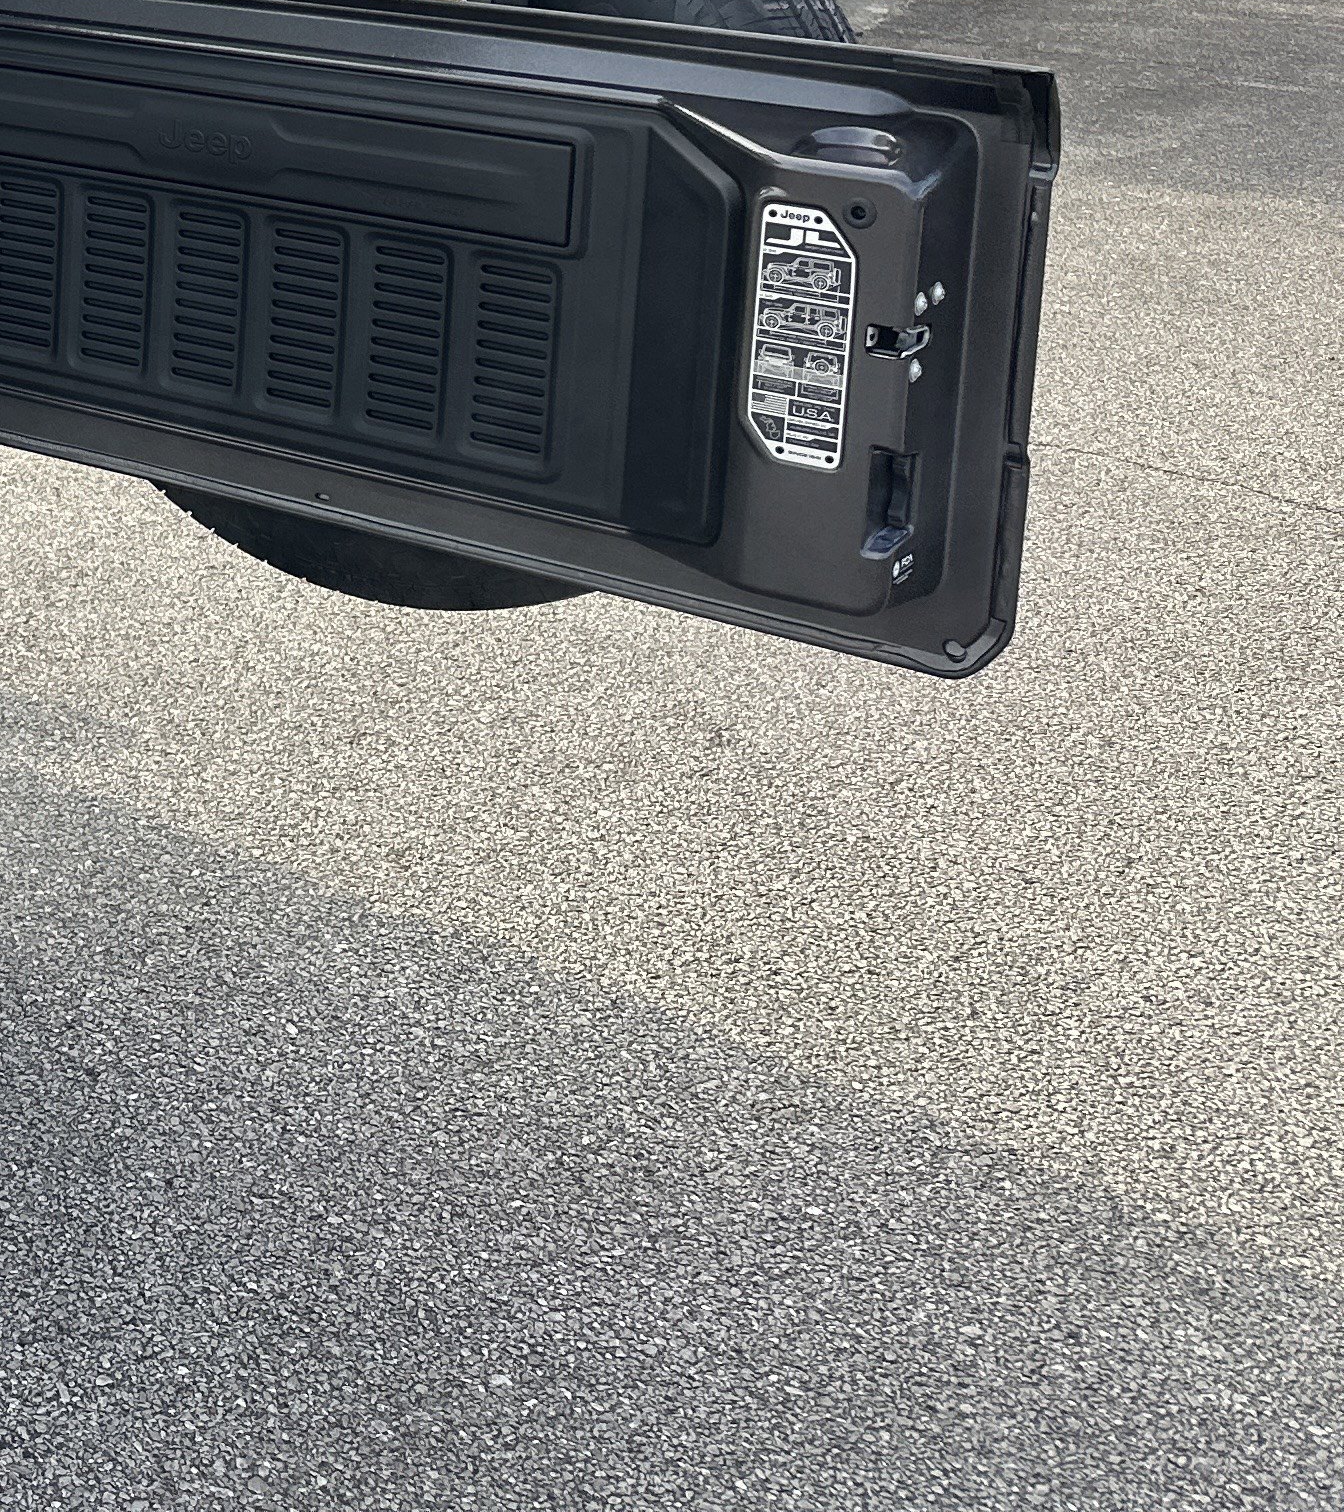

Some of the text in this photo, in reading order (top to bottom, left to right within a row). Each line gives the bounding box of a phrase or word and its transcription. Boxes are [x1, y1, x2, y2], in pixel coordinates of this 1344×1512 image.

[159, 119, 252, 164] Jeep
[780, 209, 811, 224] Jeep
[765, 227, 842, 249] JL
